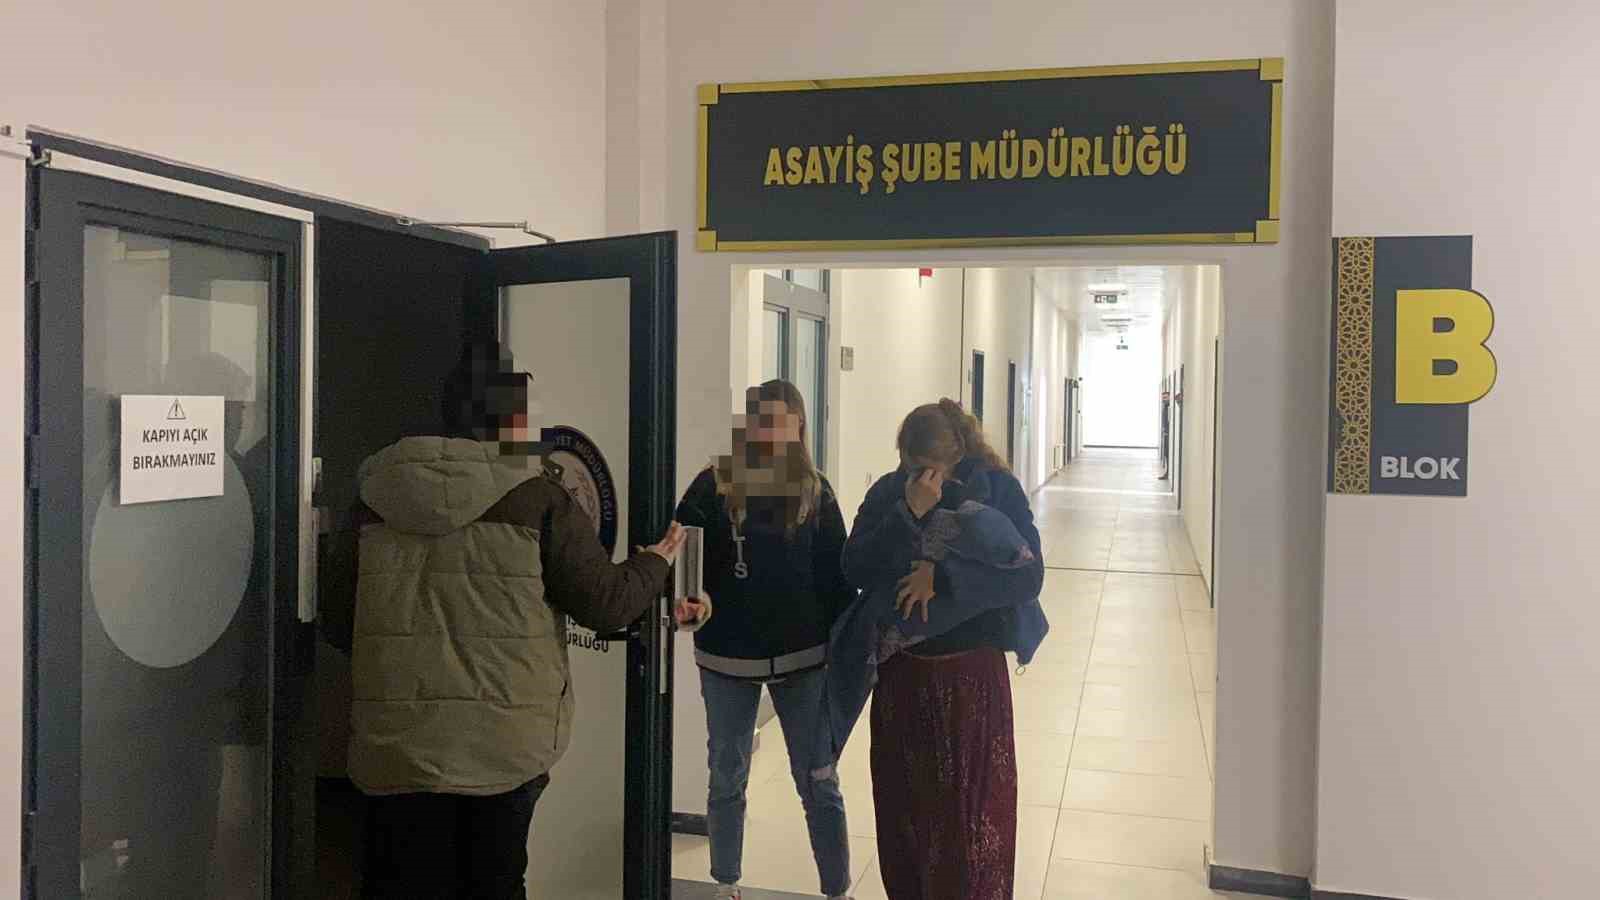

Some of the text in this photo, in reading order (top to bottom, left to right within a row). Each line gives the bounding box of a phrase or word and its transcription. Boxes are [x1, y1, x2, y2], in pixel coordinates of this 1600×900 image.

[764, 123, 1188, 194] ASAYİŞ ŞUBE MÜDÜRLÜĞÜ
[1395, 289, 1497, 405] B
[142, 427, 209, 445] KAPIYI AÇIK
[132, 452, 216, 470] BIRAKMAYINIZ
[1380, 456, 1461, 480] BLOK
